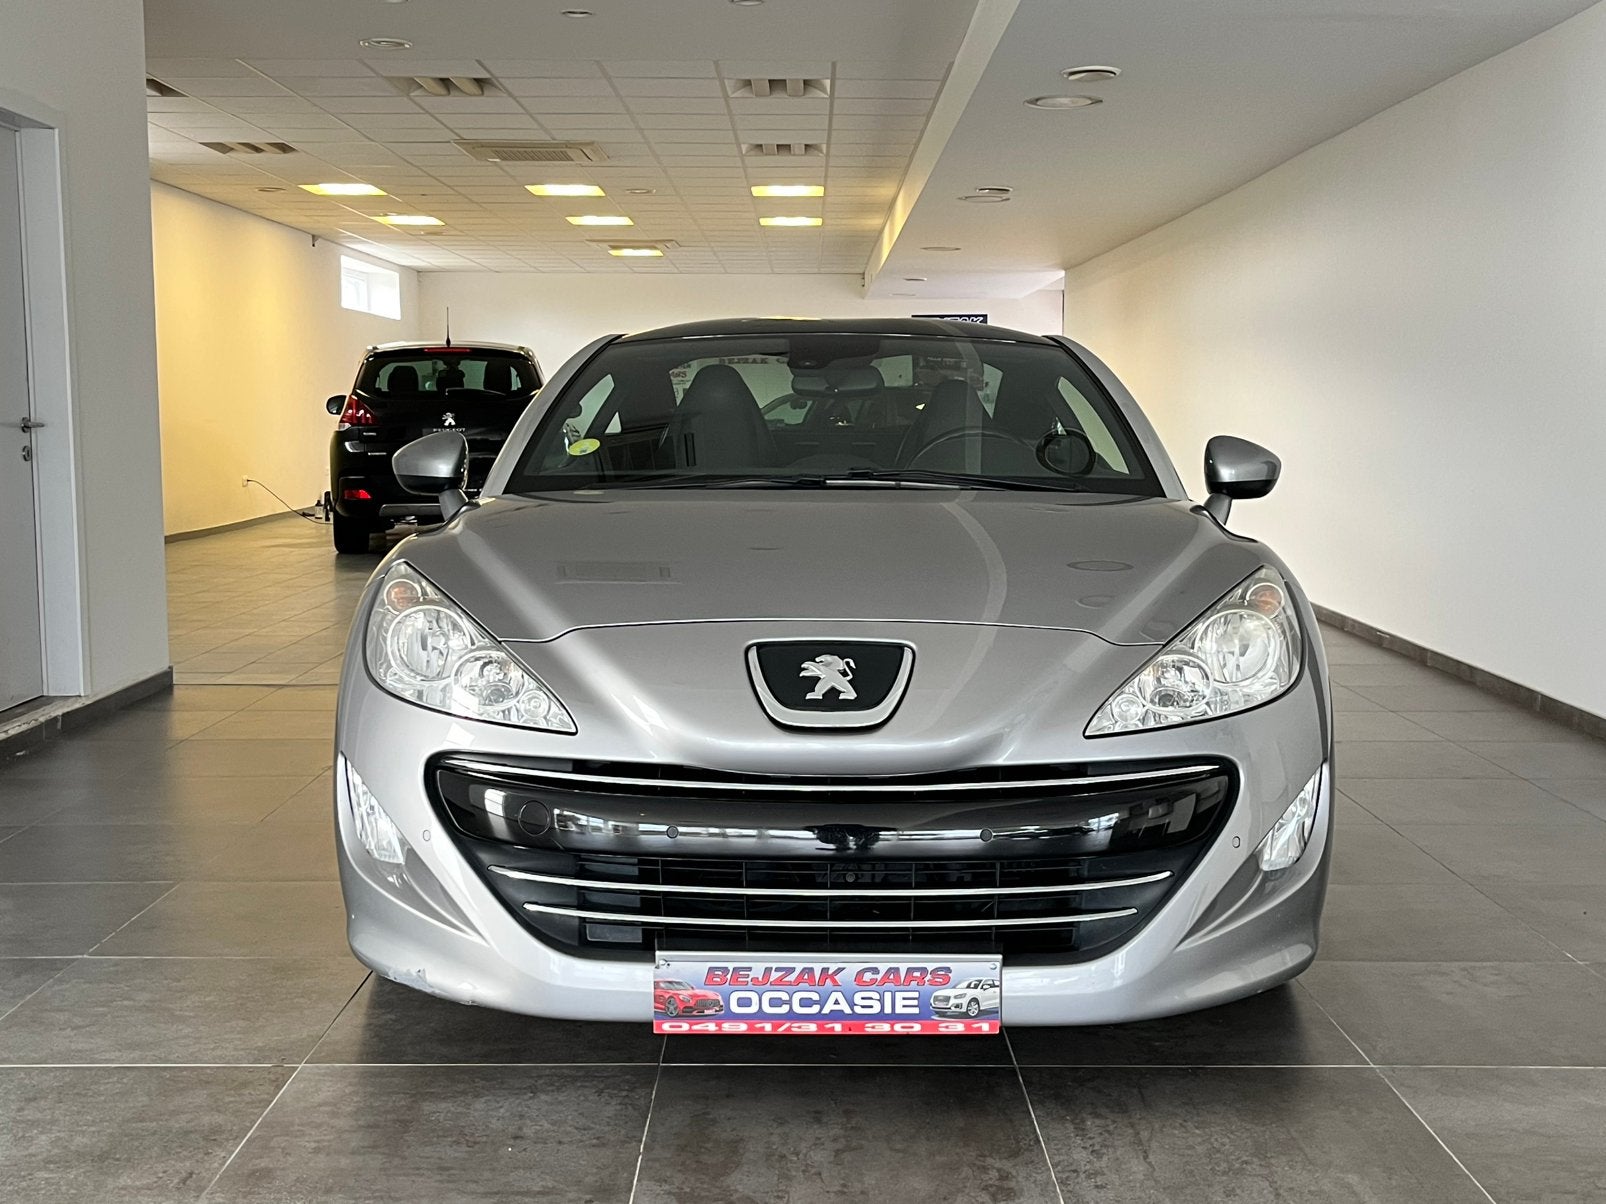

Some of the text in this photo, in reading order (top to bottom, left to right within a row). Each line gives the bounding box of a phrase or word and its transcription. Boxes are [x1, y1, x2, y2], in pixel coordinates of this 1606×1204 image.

[704, 966, 952, 987] BEJZAK CARS
[729, 990, 920, 1014] OCCASIE
[864, 1022, 921, 1032] 30
[938, 1022, 990, 1032] 31
